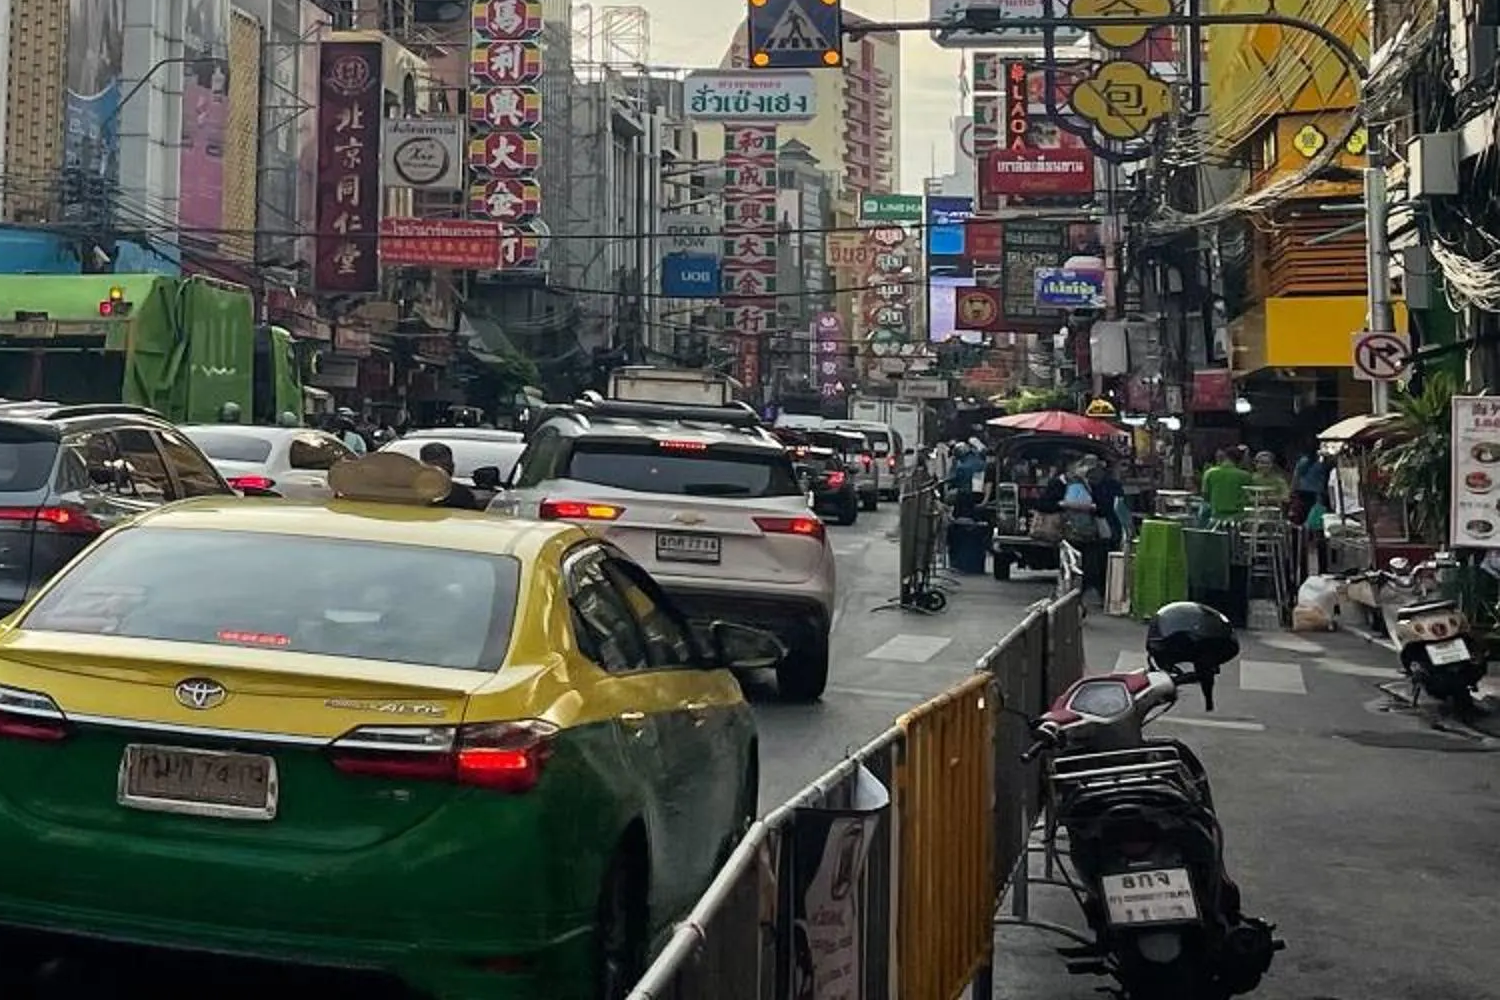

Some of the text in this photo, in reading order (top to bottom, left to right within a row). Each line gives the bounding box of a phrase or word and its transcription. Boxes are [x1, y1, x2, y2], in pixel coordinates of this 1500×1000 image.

[333, 100, 365, 275] 北京同仁堂
[681, 271, 712, 282] UOB
